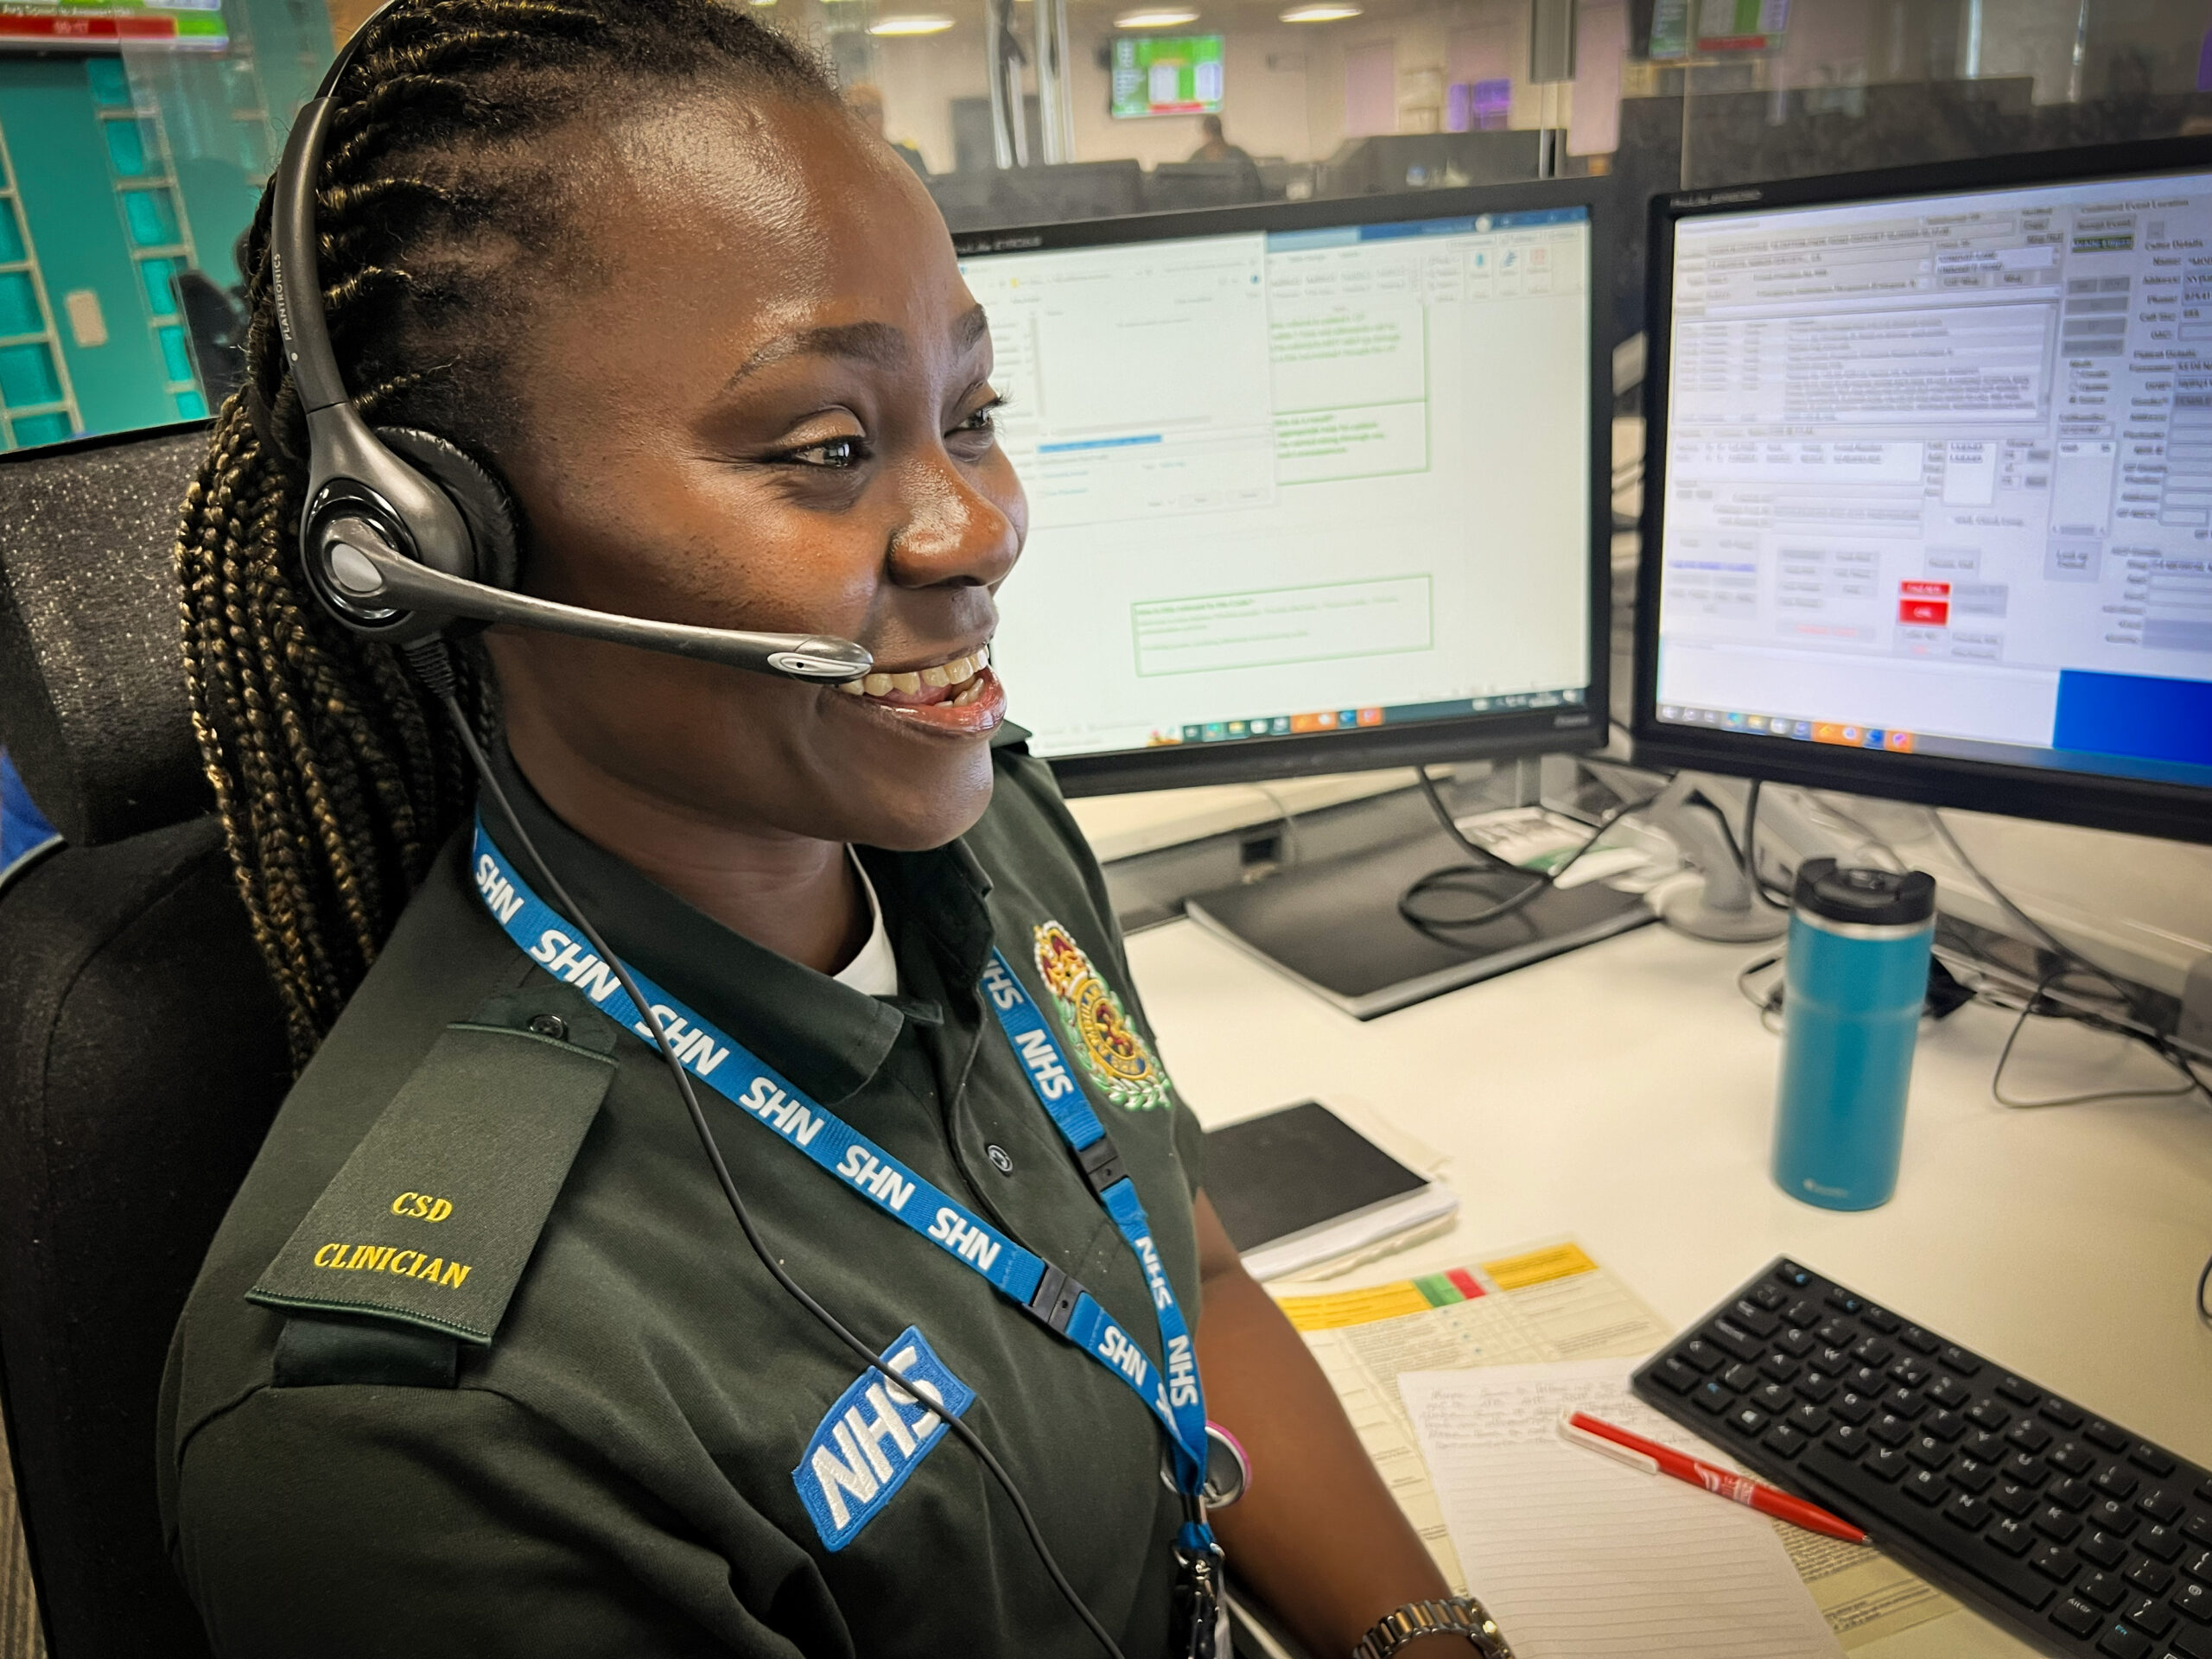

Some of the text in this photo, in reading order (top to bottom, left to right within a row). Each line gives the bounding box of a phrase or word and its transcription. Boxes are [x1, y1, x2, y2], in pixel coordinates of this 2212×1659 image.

[274, 253, 292, 340] PLANTRONICS
[1015, 1027, 1074, 1101] NHS
[391, 1192, 453, 1223] CSD
[314, 1243, 472, 1289] CLINICIAN
[1135, 1236, 1173, 1310] NHS
[1167, 1334, 1198, 1407] NHS
[810, 1344, 944, 1531] NHS
